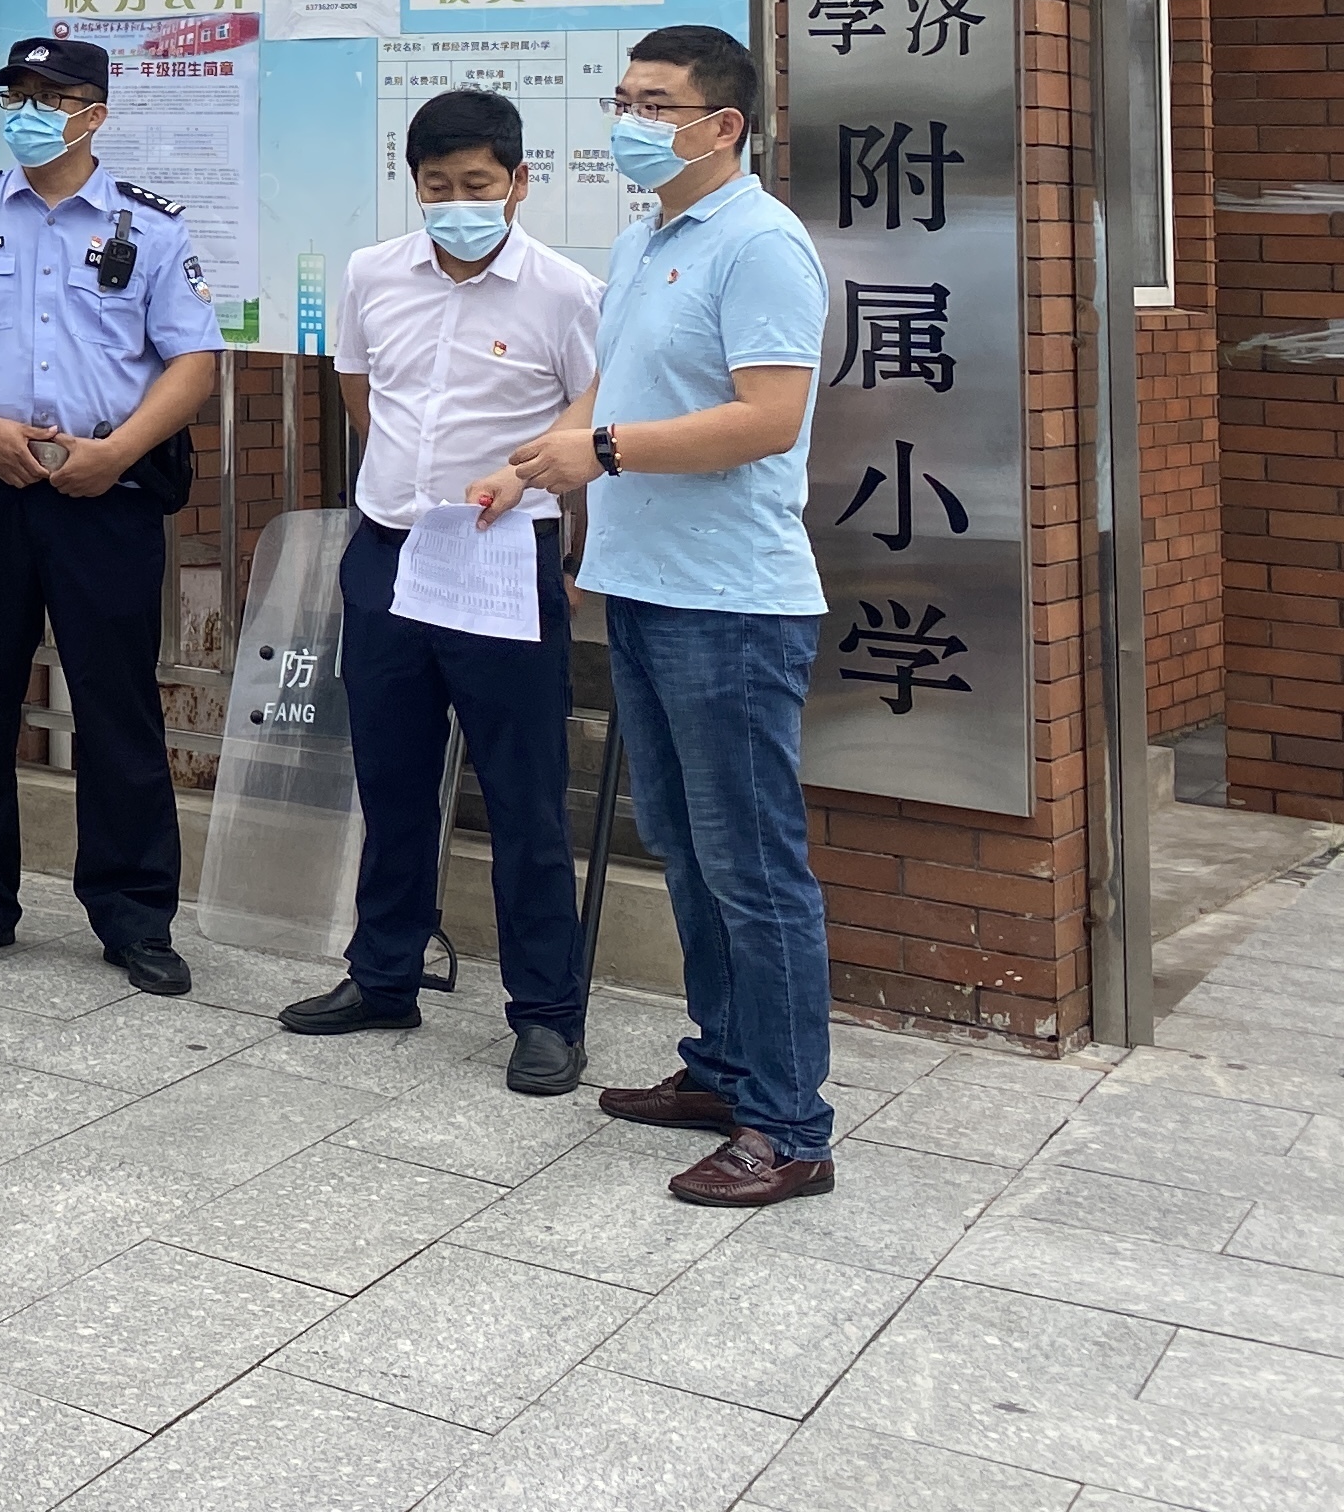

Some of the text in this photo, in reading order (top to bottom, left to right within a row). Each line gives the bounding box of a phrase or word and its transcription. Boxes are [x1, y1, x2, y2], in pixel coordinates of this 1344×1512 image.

[465, 68, 505, 80] 收费标准
[582, 64, 603, 75] 备注
[410, 75, 448, 87] 收费项目
[828, 120, 973, 715] 附属小学
[278, 648, 318, 688] 防
[262, 702, 316, 724] FANG
